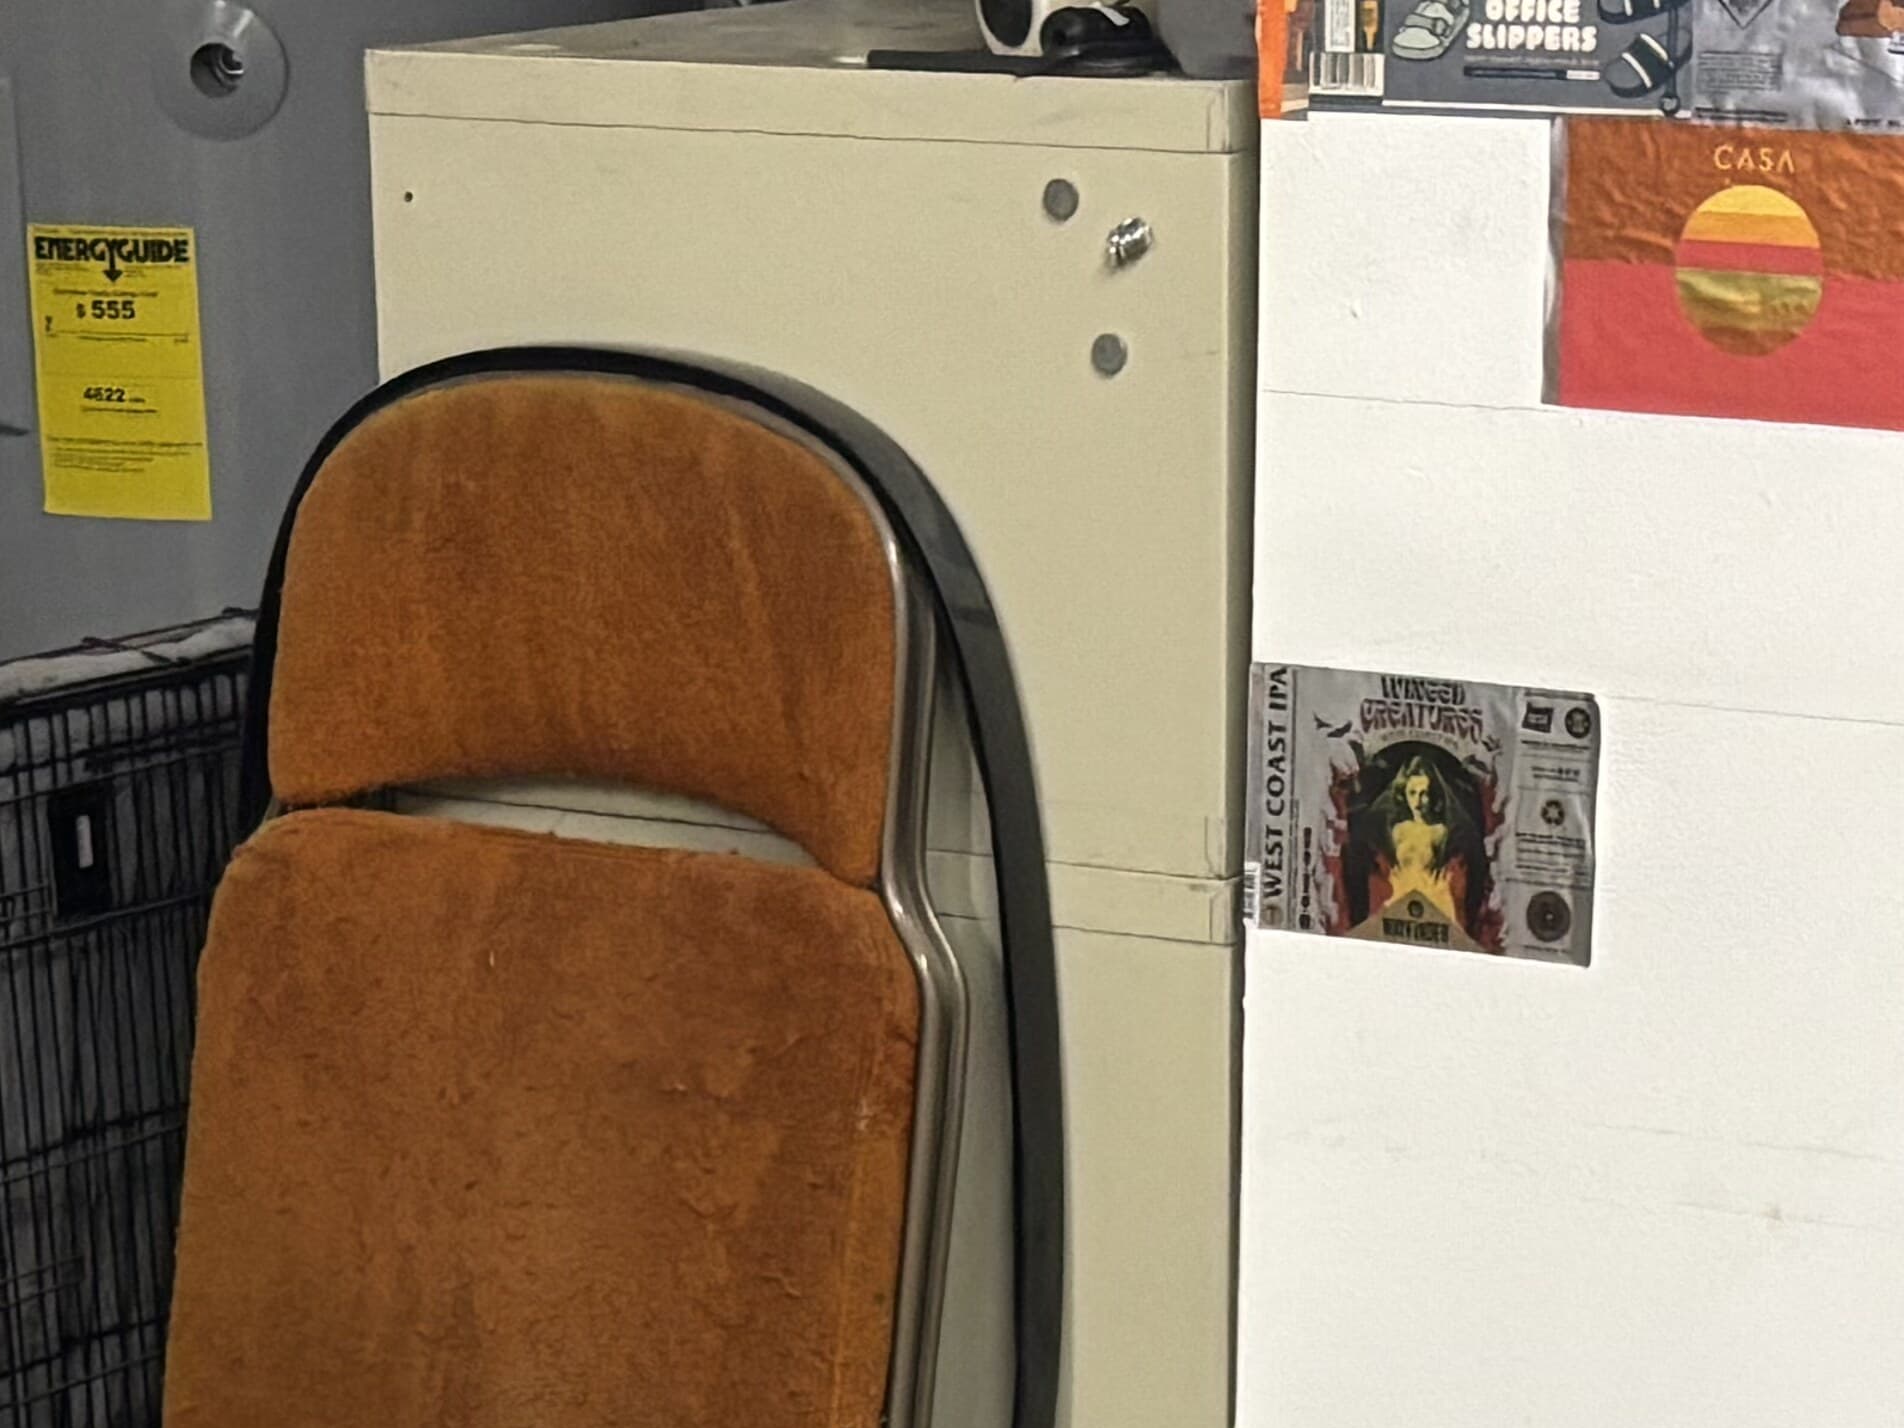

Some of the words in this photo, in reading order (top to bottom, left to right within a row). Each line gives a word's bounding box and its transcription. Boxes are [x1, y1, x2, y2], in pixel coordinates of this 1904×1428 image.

[1485, 0, 1581, 23] OFFICE
[1465, 22, 1598, 52] SLIPPERS
[1713, 145, 1795, 173] CASA
[34, 236, 190, 266] ENERGYGUIDE
[1268, 666, 1289, 713] IPA
[1359, 698, 1484, 745] CREATURES
[1265, 724, 1286, 818] COAST
[1262, 824, 1284, 899] WEST
